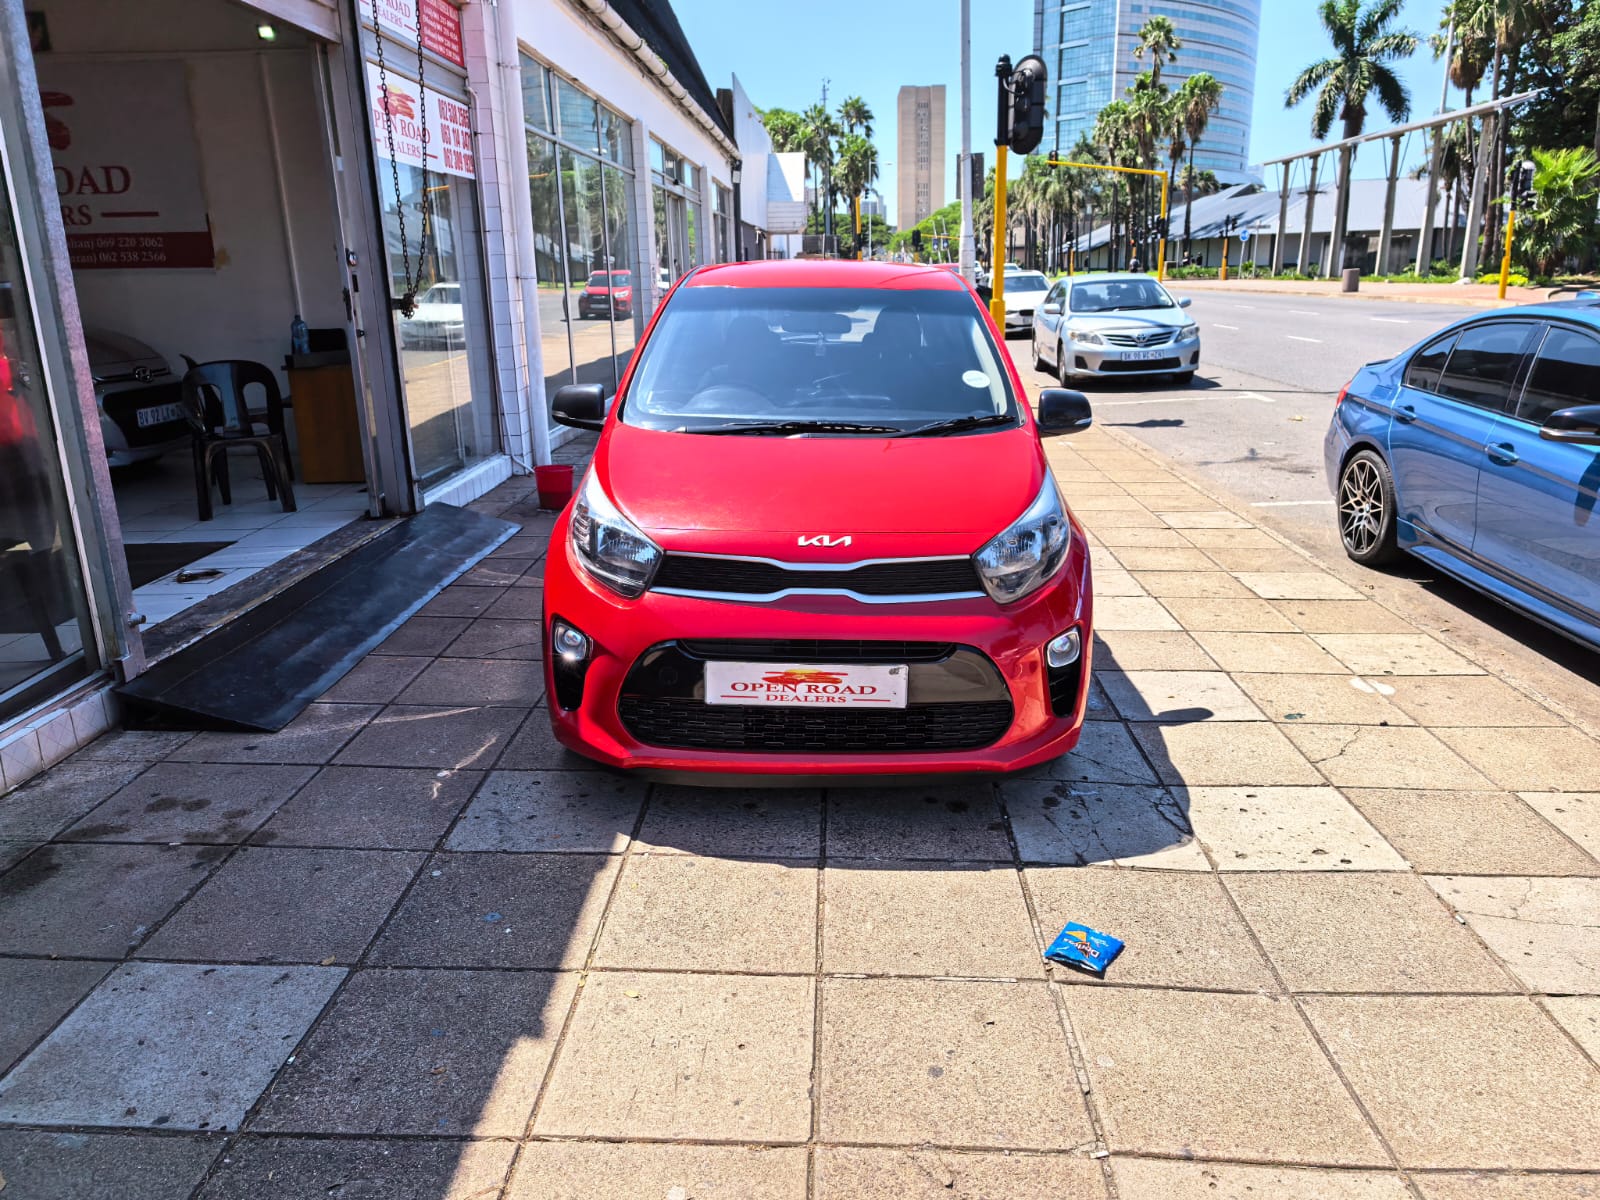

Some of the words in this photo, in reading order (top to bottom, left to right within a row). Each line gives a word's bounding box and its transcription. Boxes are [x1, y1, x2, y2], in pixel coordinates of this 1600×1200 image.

[373, 109, 398, 134] PEN
[384, 136, 422, 159] DALERS
[53, 165, 131, 195] OAD
[117, 238, 137, 248] 220
[120, 251, 139, 262] 538
[798, 534, 852, 547] KIA
[730, 682, 797, 694] OPEN
[806, 684, 878, 696] ROAD
[766, 694, 847, 704] DEALERS
